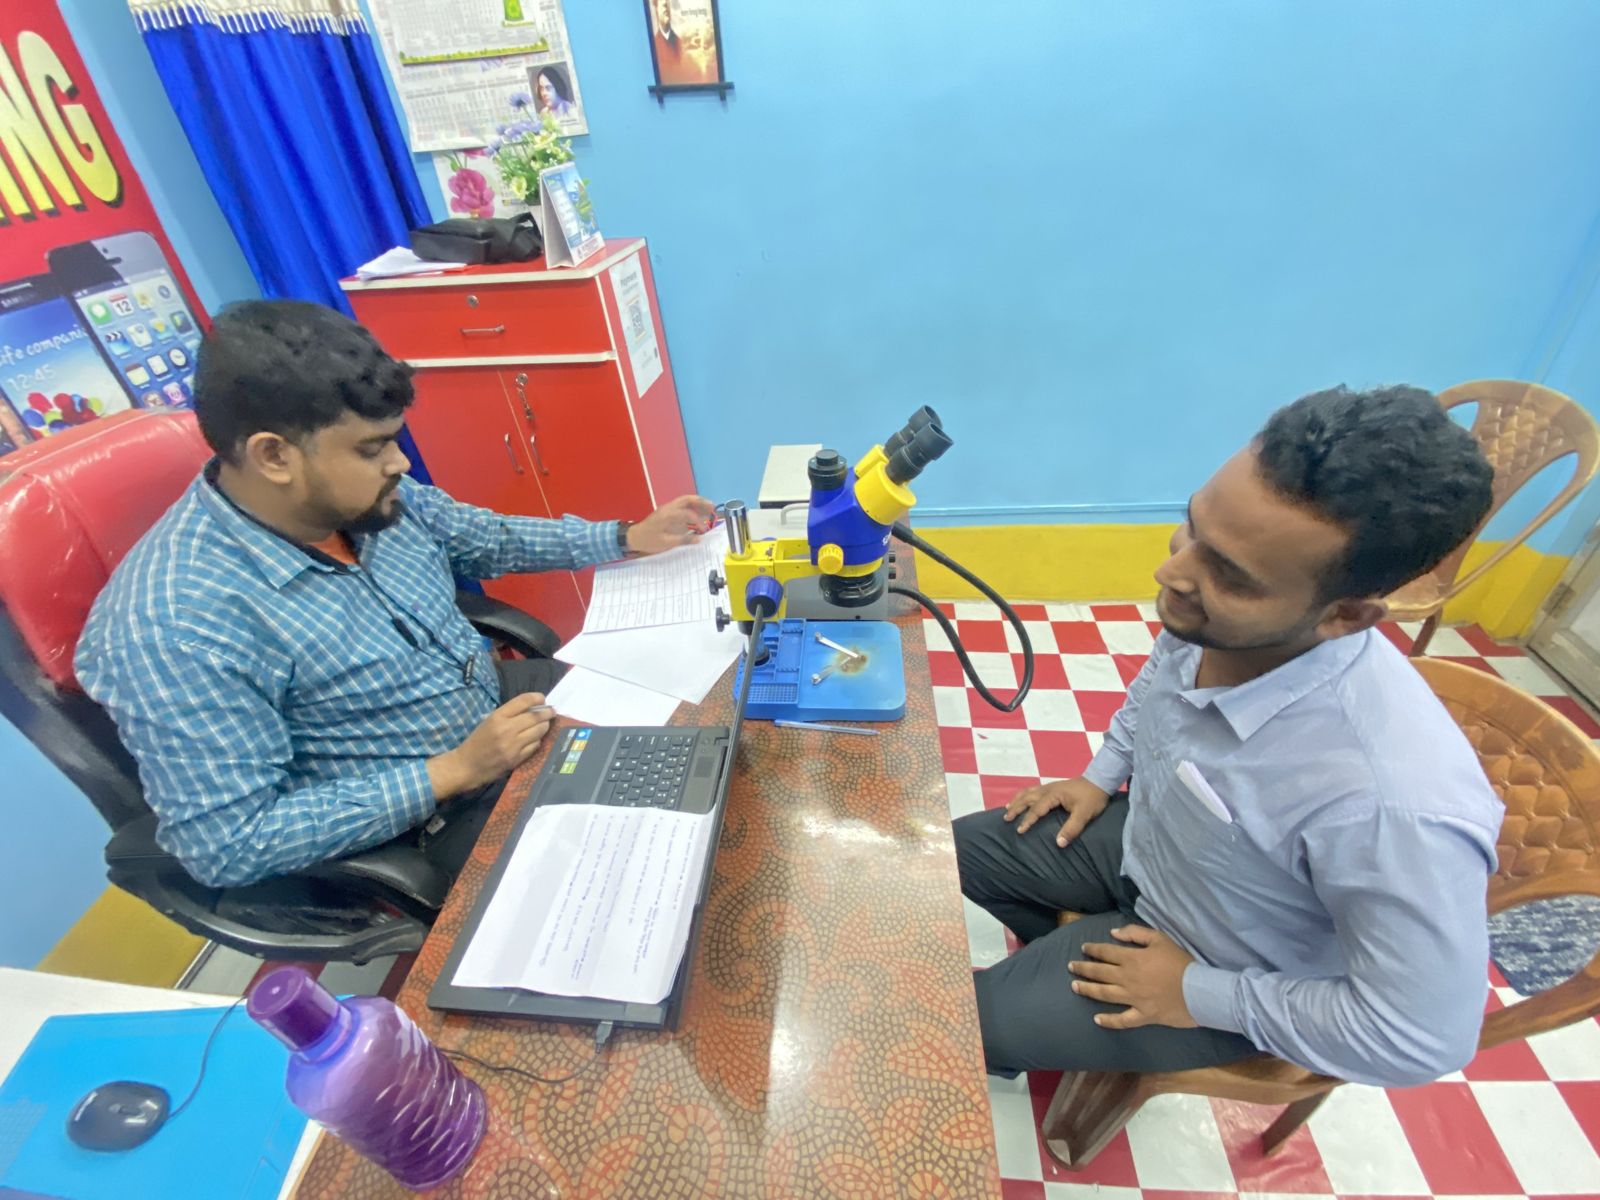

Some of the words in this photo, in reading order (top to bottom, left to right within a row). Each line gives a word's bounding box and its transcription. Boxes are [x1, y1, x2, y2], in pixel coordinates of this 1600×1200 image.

[0, 30, 120, 217] NG
[116, 300, 132, 314] 12
[26, 323, 89, 355] compani
